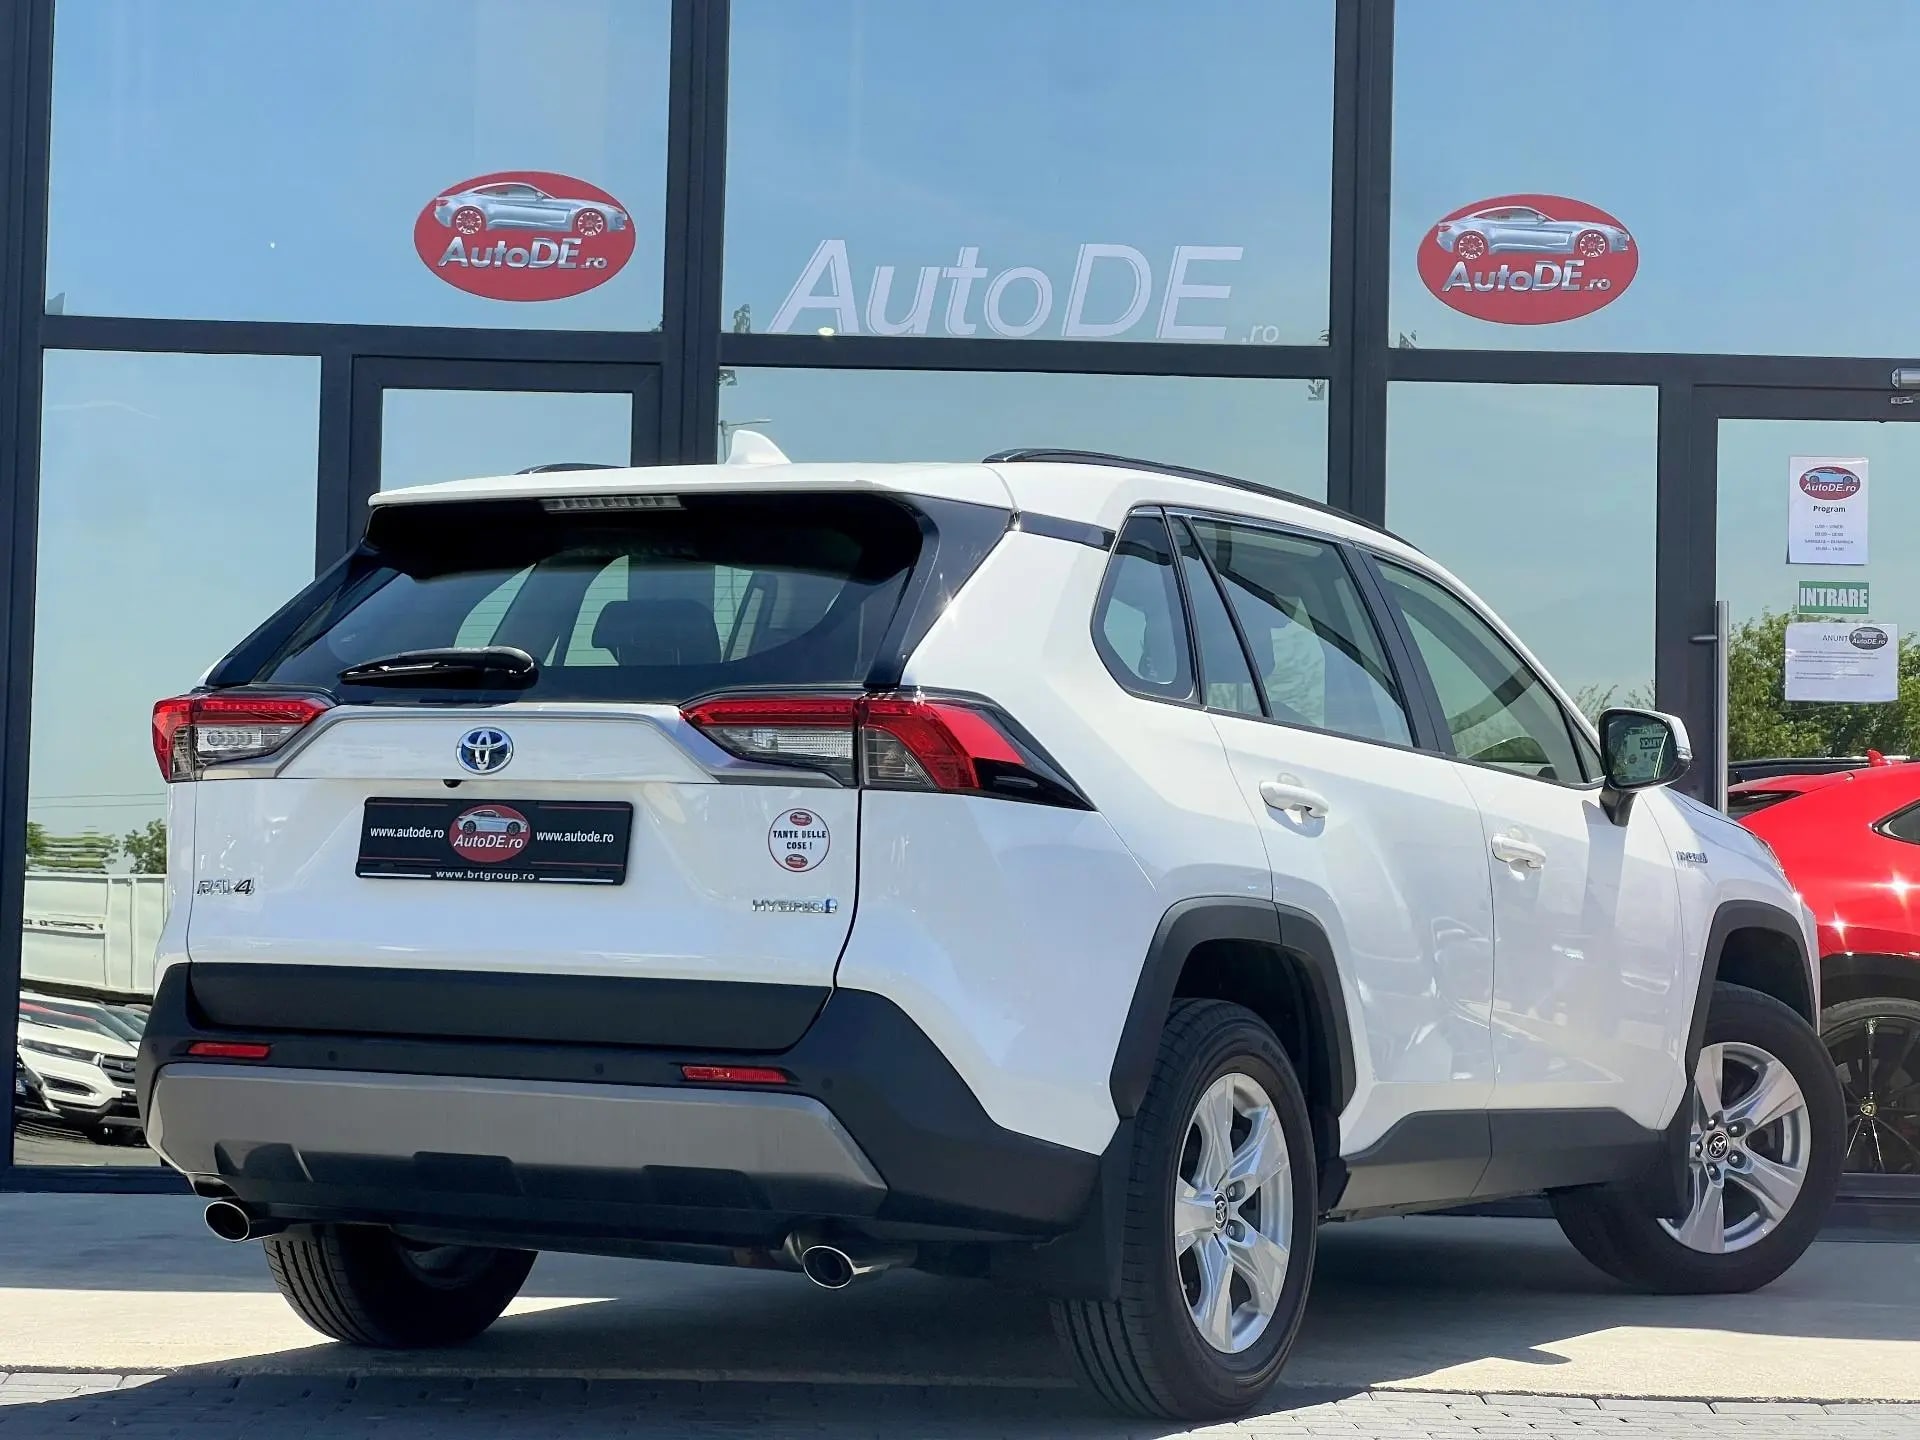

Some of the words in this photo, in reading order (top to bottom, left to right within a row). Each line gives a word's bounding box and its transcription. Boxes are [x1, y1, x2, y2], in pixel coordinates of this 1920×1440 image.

[1804, 483, 1857, 493] AutoDE.ro
[1813, 505, 1846, 514] Program
[1800, 587, 1868, 608] INTRARE
[370, 826, 444, 839] www.autode.ro
[536, 830, 614, 843] www.autode.ro
[773, 830, 798, 839] TANTE
[802, 830, 827, 839] BELLE
[453, 833, 524, 849] AutoDE.ro
[786, 842, 807, 850] COSE
[436, 870, 535, 882] www.brtgroup.ro
